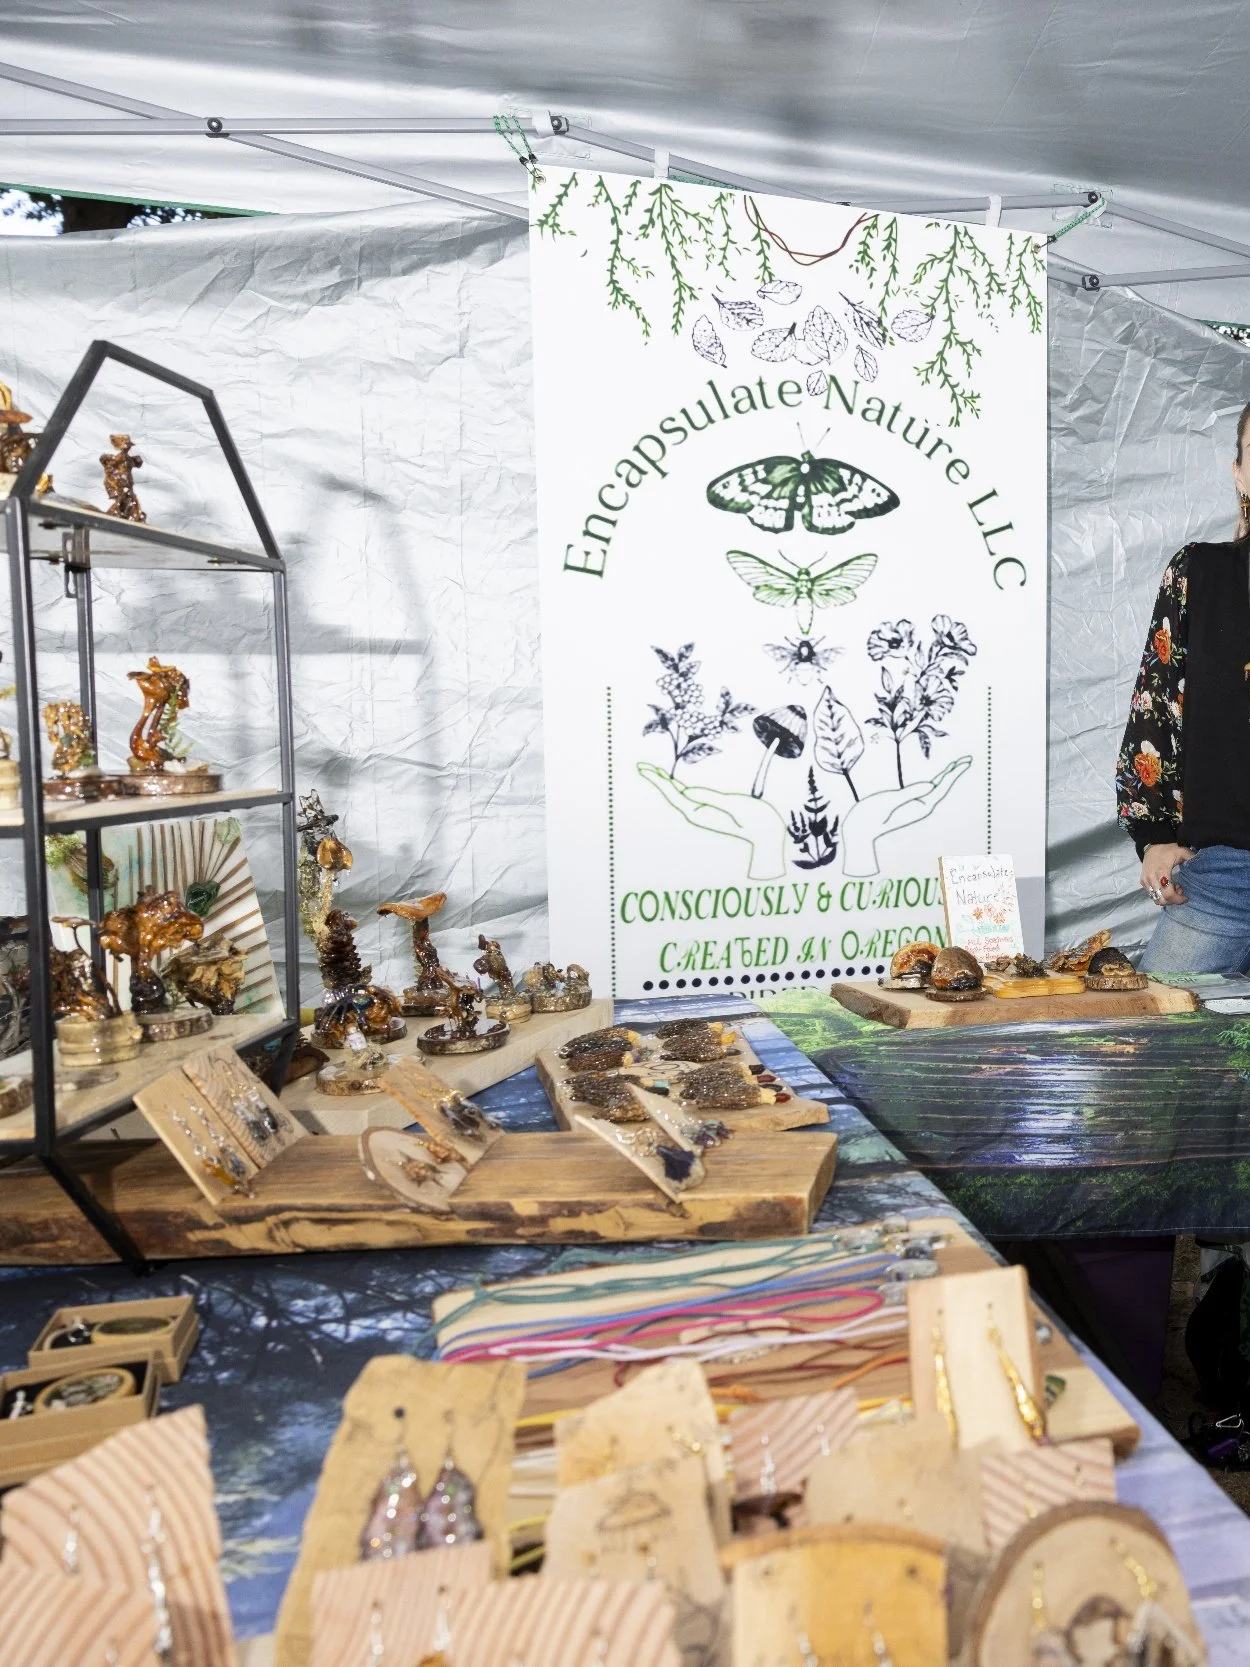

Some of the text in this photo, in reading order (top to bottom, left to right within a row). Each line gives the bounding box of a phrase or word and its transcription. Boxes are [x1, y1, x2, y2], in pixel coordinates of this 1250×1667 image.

[563, 373, 1028, 592] Encapsulate Nature LLC
[620, 876, 945, 924] CONSCIOUSLY & CURIOU
[955, 888, 1000, 906] Nature
[659, 935, 789, 974] CREATED
[796, 934, 832, 964] IN
